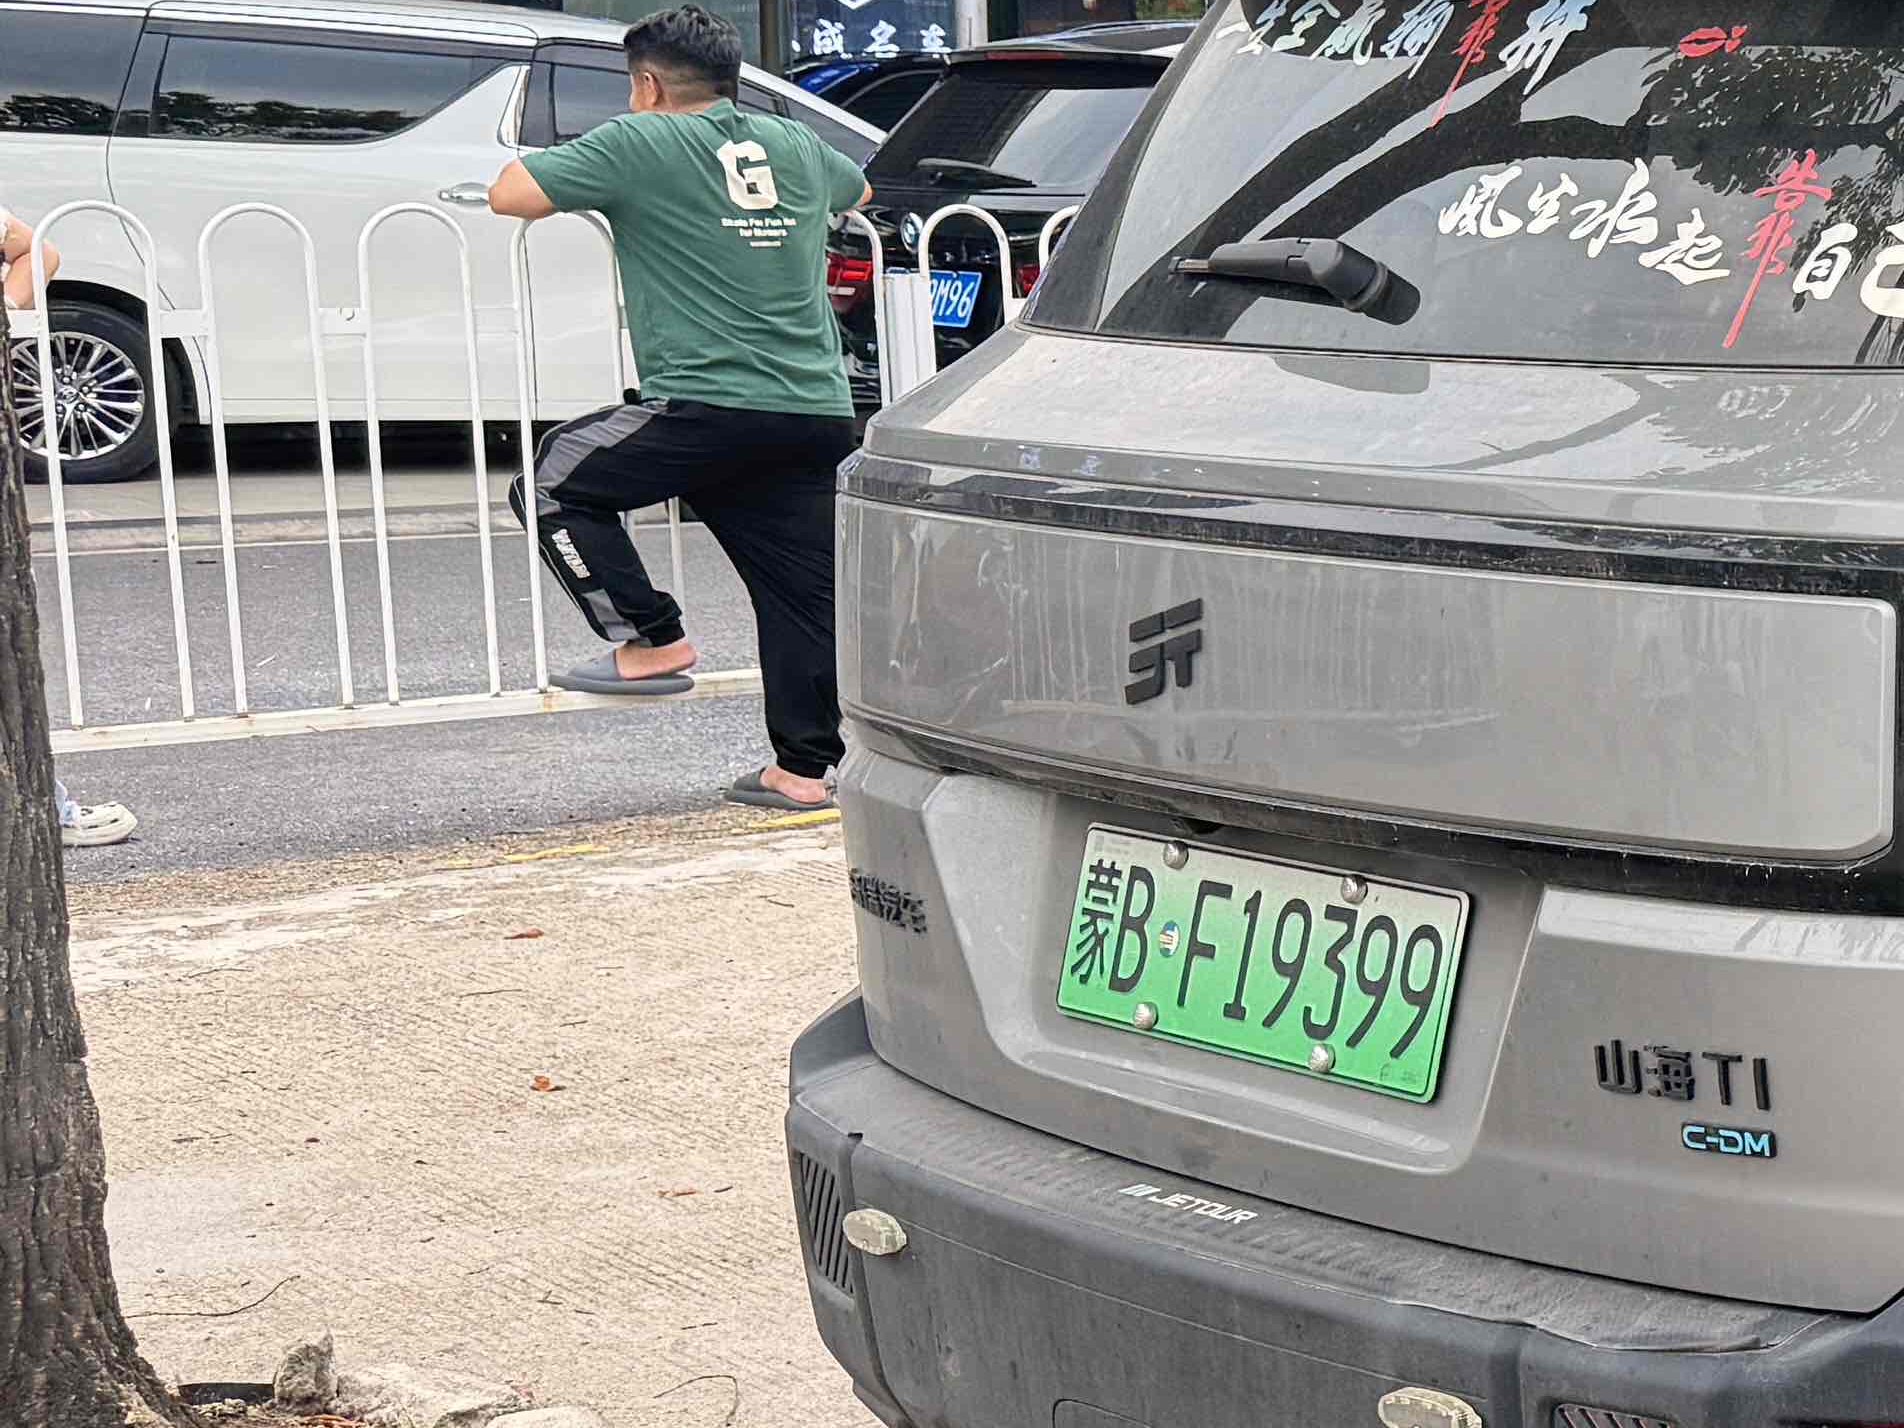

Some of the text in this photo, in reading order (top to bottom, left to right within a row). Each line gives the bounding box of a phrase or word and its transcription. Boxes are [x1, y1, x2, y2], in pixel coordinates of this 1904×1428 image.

[791, 19, 951, 59] 成名车
[1683, 1124, 1771, 1158] C-DM
[1147, 1192, 1258, 1225] JETOUR
